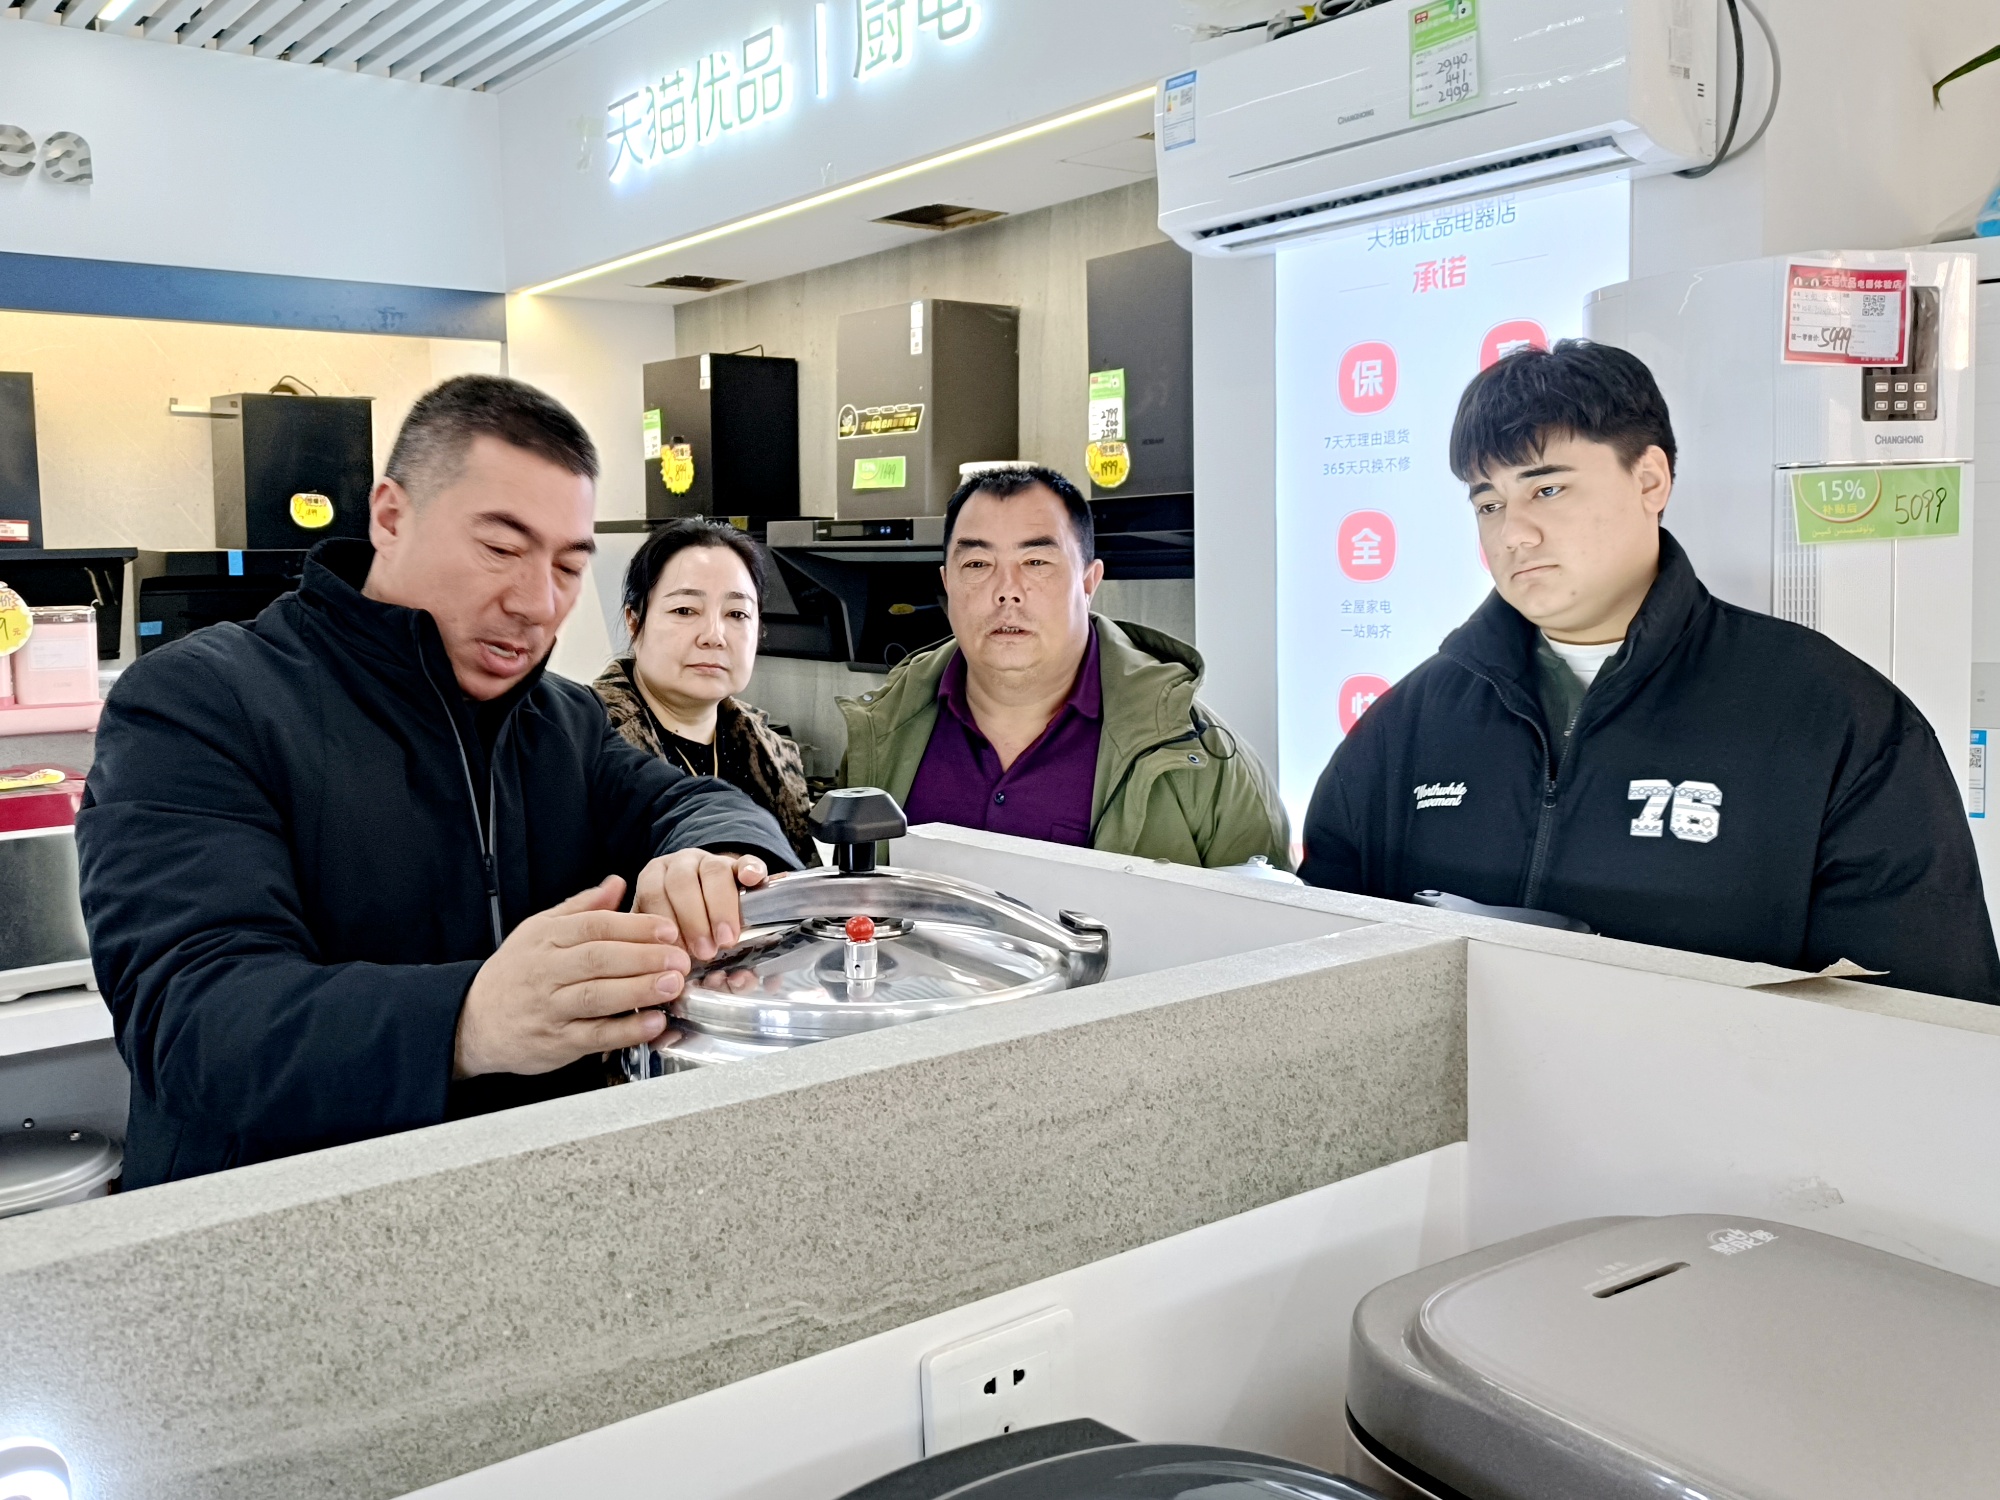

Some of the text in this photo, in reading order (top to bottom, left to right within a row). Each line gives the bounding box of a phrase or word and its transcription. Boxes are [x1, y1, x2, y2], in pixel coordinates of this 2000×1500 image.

[1435, 53, 1468, 75] 2940
[1445, 69, 1466, 85] 441
[606, 26, 785, 180] 天猫优品
[1438, 82, 1469, 102] 2499
[1412, 254, 1467, 294] 承诺
[1818, 326, 1852, 356] 5999
[1352, 359, 1384, 398] 保
[1324, 429, 1410, 450] 7天无理由退货
[1874, 434, 1924, 445] CHANGHONG
[1323, 456, 1411, 476] 365天只换不修
[1817, 479, 1866, 502] 15%
[1822, 503, 1858, 516] 补贴后
[1894, 487, 1948, 525] 5099
[1351, 527, 1382, 566] 全
[1340, 599, 1393, 615] 全屋家电
[1340, 624, 1393, 639] 一站购齐
[1627, 778, 1723, 843] 76
